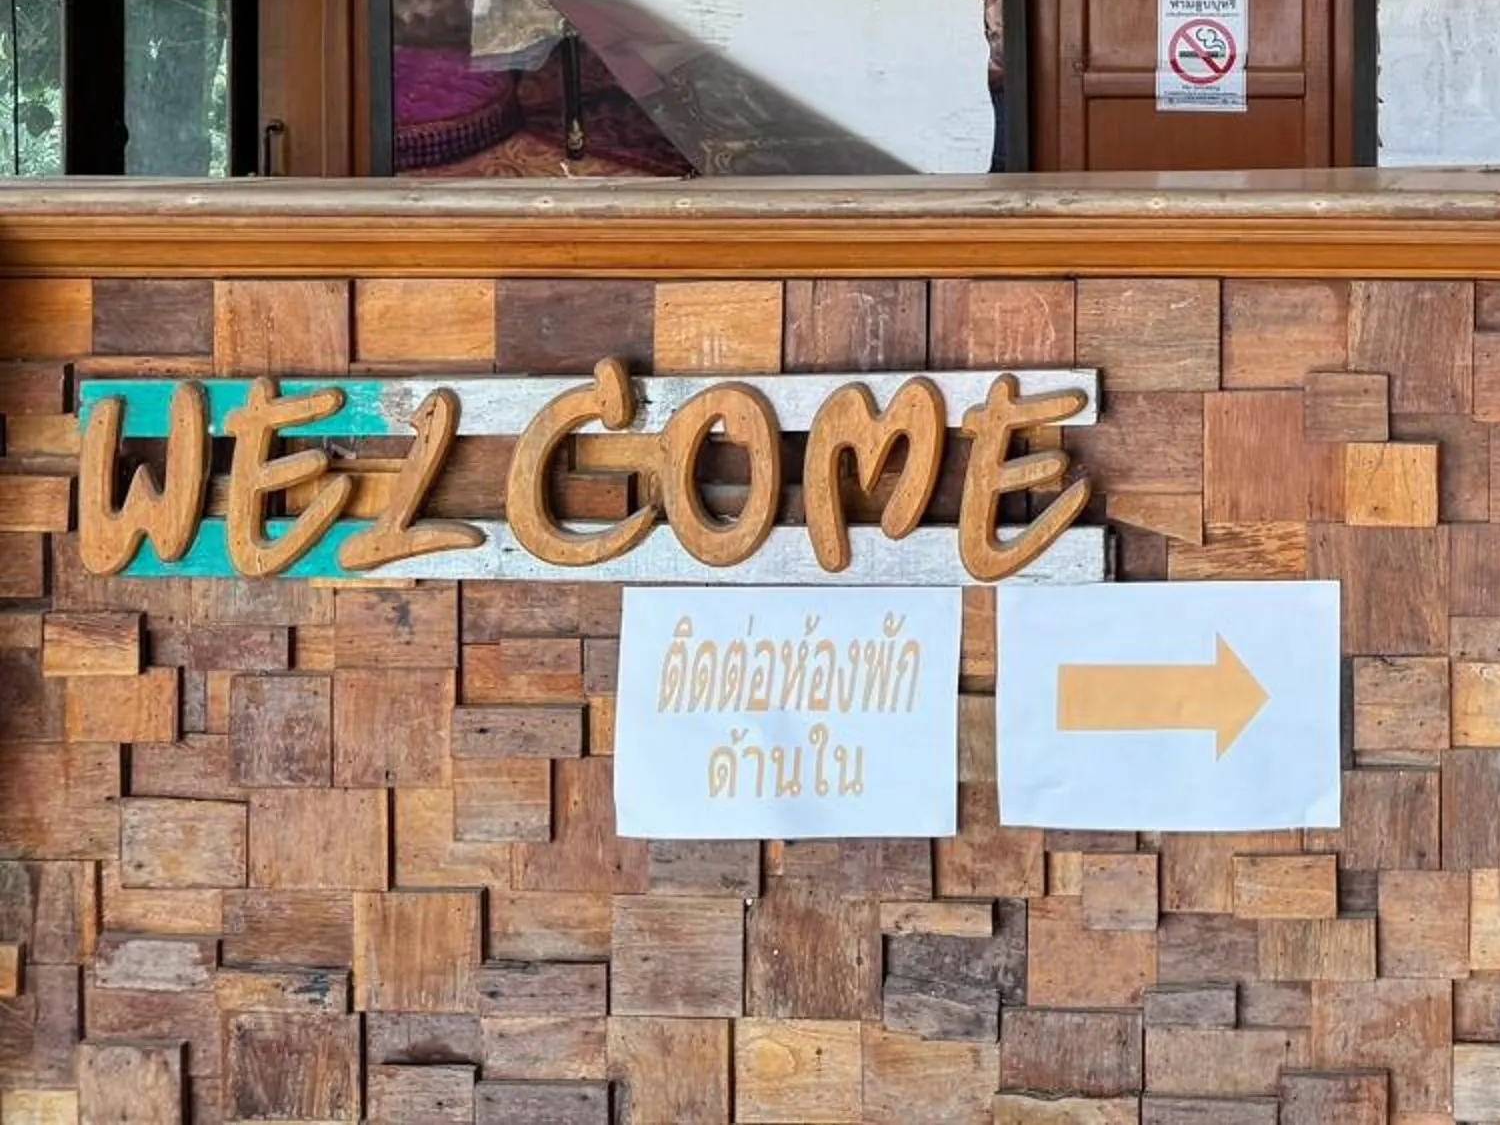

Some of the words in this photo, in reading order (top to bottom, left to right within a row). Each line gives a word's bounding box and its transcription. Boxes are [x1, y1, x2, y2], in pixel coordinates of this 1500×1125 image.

[78, 358, 1092, 581] WELCOME
[656, 610, 922, 715] ติดต่อห้องพัก
[706, 723, 865, 799] ด้านใน
